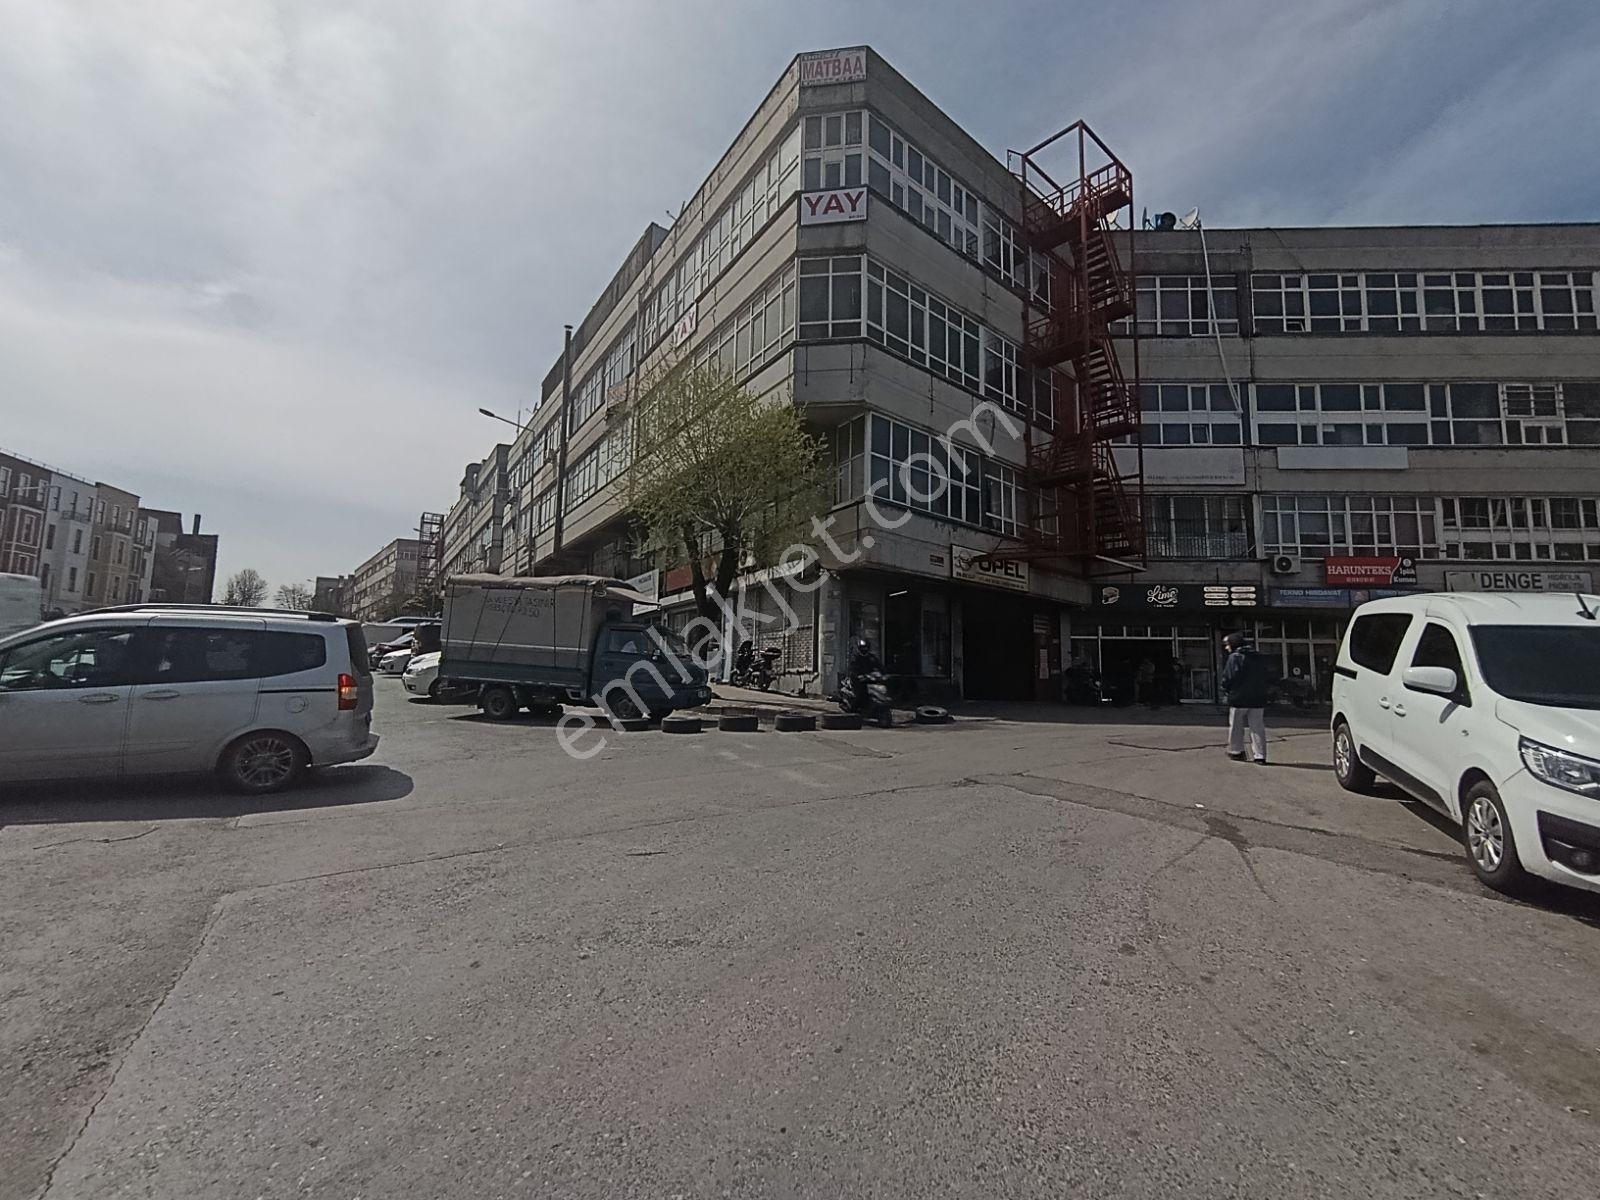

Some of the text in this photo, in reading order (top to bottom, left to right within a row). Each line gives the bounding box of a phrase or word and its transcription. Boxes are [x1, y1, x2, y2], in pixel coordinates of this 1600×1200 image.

[802, 55, 865, 80] MATBAA
[803, 191, 865, 216] YAY
[979, 558, 1026, 580] OPEL
[1327, 565, 1392, 576] HARUNTEKS
[1480, 573, 1543, 589] DENGE
